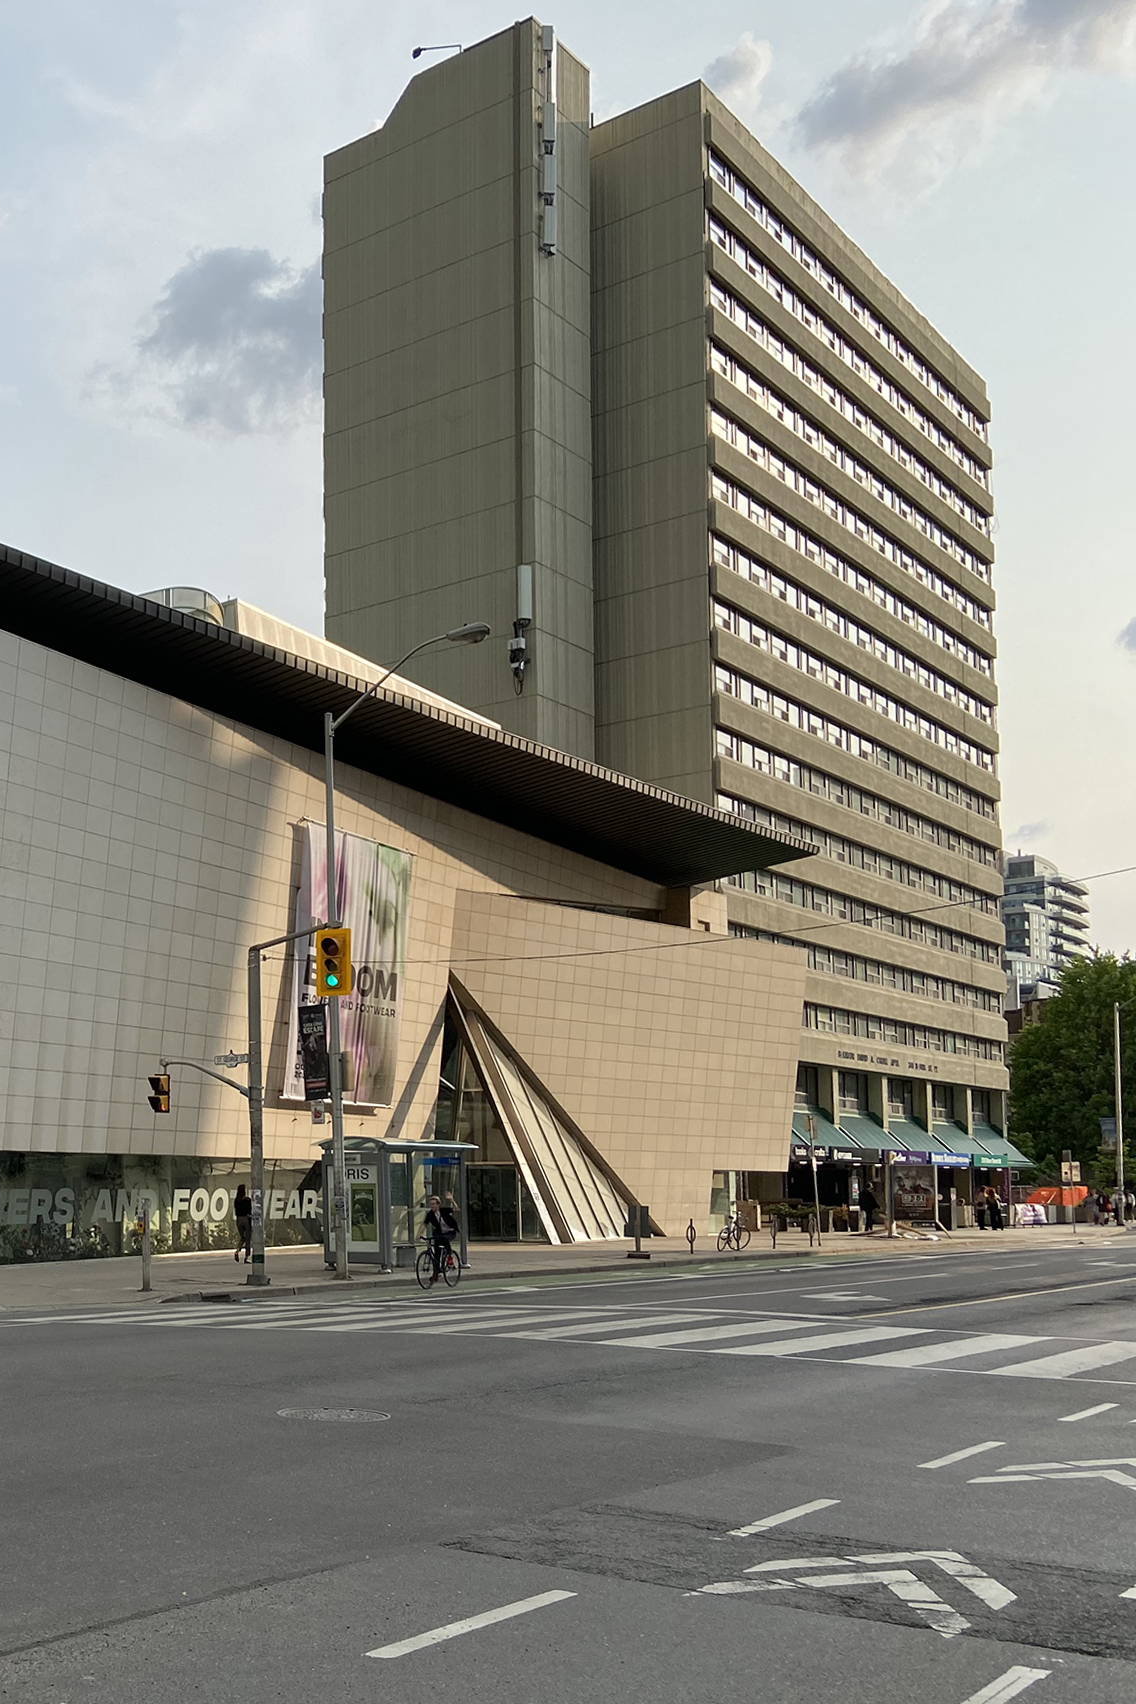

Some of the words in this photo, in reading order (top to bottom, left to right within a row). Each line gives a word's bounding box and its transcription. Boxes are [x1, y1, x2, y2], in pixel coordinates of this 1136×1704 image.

[304, 954, 398, 1002] BOM
[356, 1002, 396, 1018] FOOTWEAR
[302, 1026, 324, 1034] ESCAPE
[345, 1168, 369, 1180] RIS
[90, 1188, 158, 1222] AND
[172, 1187, 318, 1222] FOOEAR
